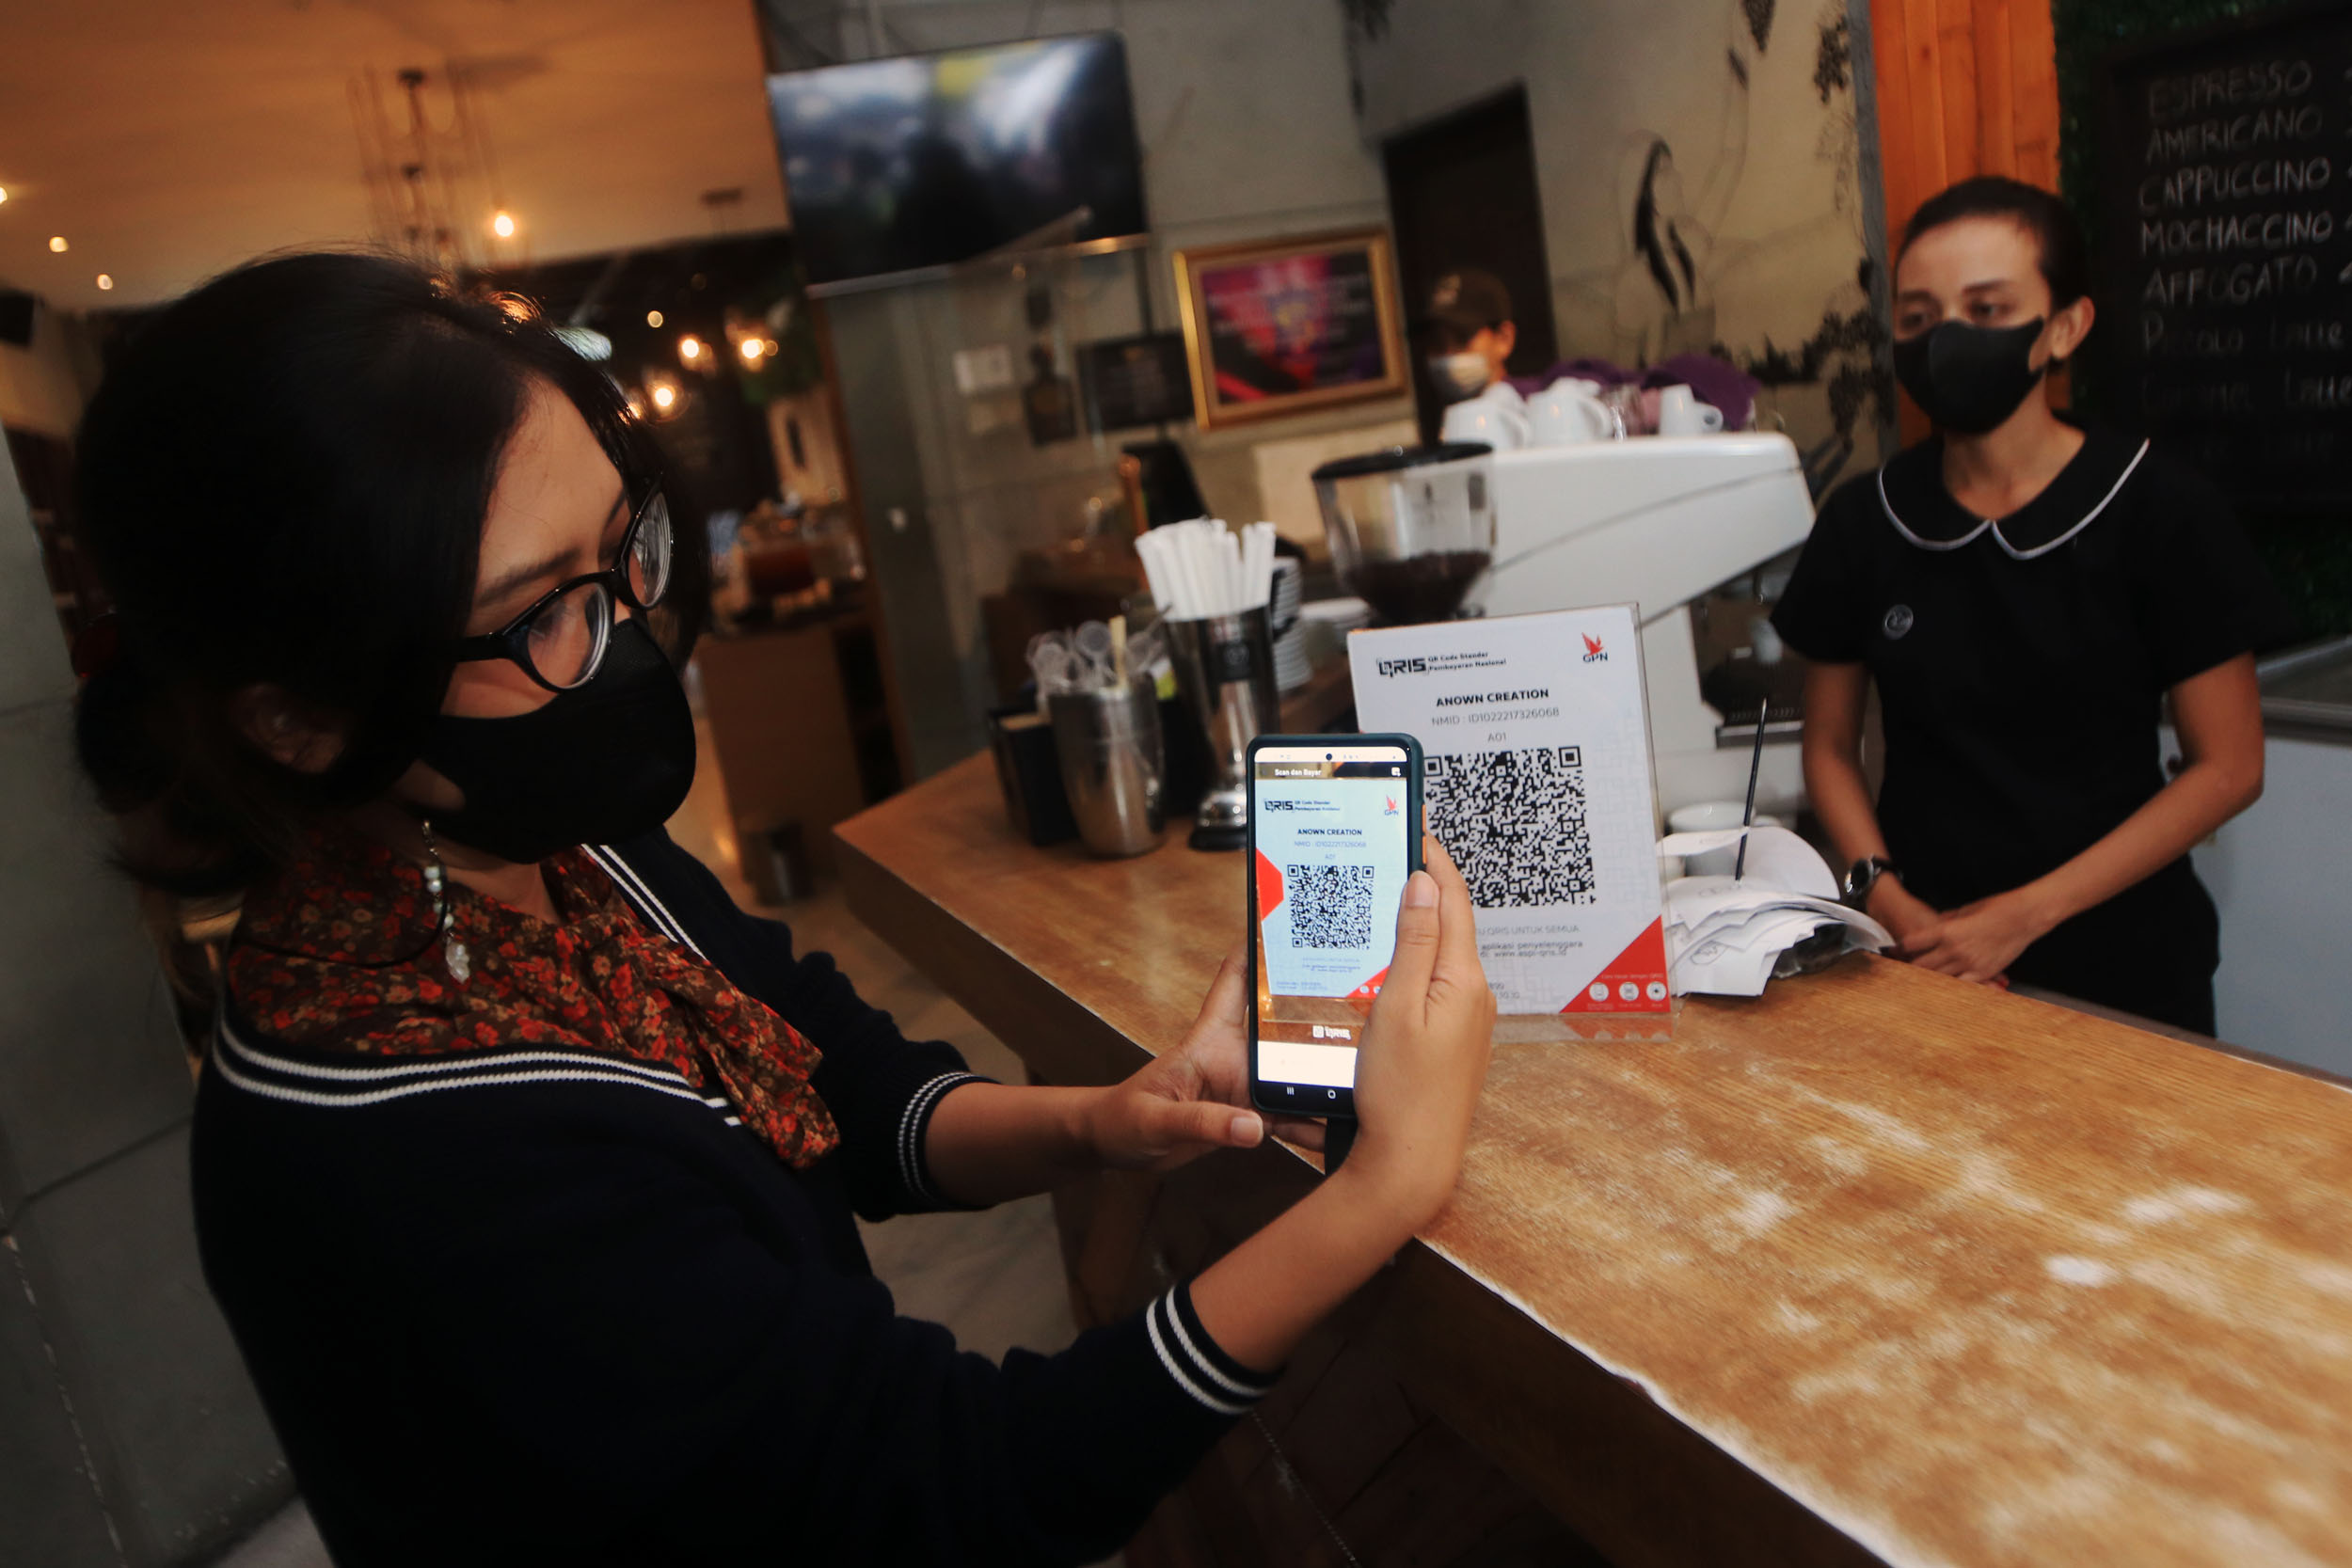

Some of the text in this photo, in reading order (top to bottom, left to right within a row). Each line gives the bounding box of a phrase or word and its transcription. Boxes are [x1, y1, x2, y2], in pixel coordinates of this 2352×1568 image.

[2148, 59, 2312, 119] ESPRESSO
[2144, 104, 2323, 166] AMERICANO
[2137, 156, 2331, 217] CAPPUCCINO
[2140, 210, 2333, 261] MOCHACCINO
[2141, 255, 2318, 309] AFFOGATO
[1378, 657, 1427, 678] QRIS
[1440, 654, 1457, 662] Code
[1582, 652, 1609, 663] GPN
[1437, 689, 1549, 708] ANOWN CREATION
[1431, 715, 1460, 727] NMID
[1487, 732, 1507, 743] A01
[1264, 800, 1294, 813] QRIS
